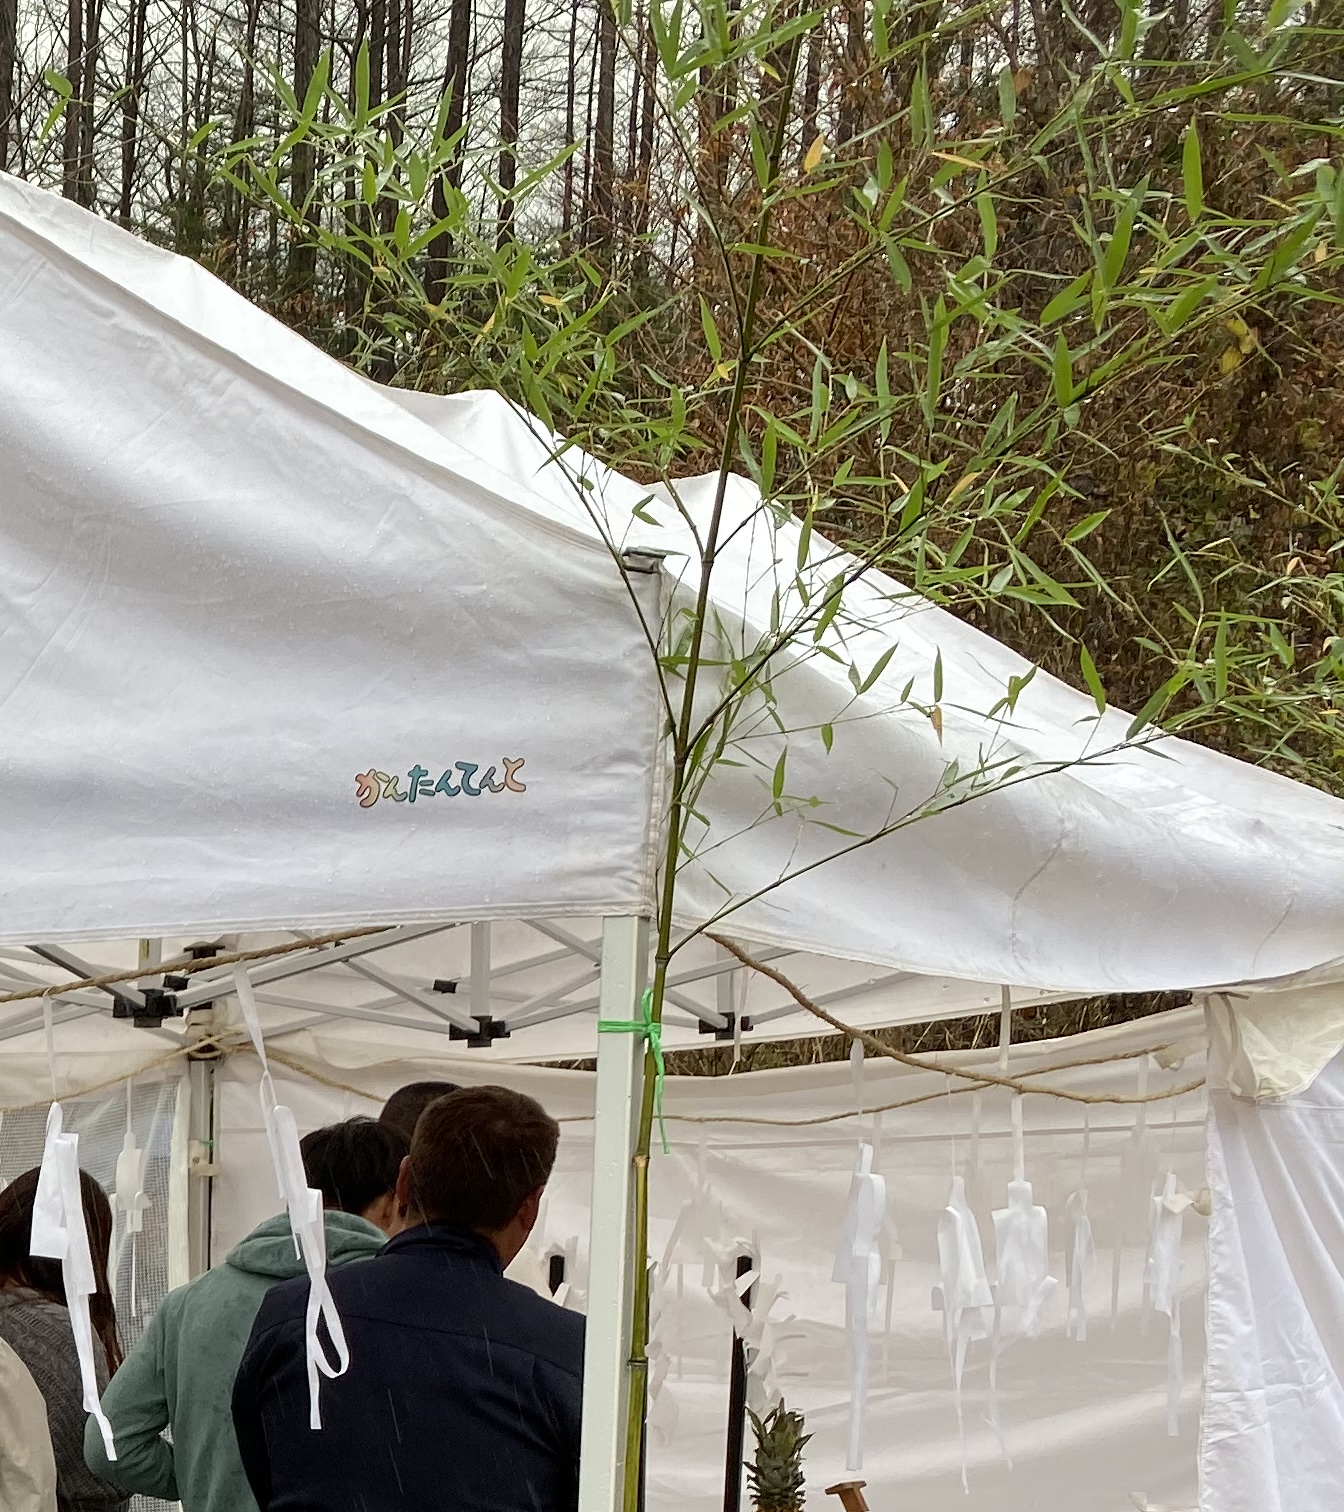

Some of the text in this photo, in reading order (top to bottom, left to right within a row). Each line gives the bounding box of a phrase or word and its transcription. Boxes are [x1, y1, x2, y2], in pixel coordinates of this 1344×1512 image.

[355, 757, 527, 808] かんたんてんと
